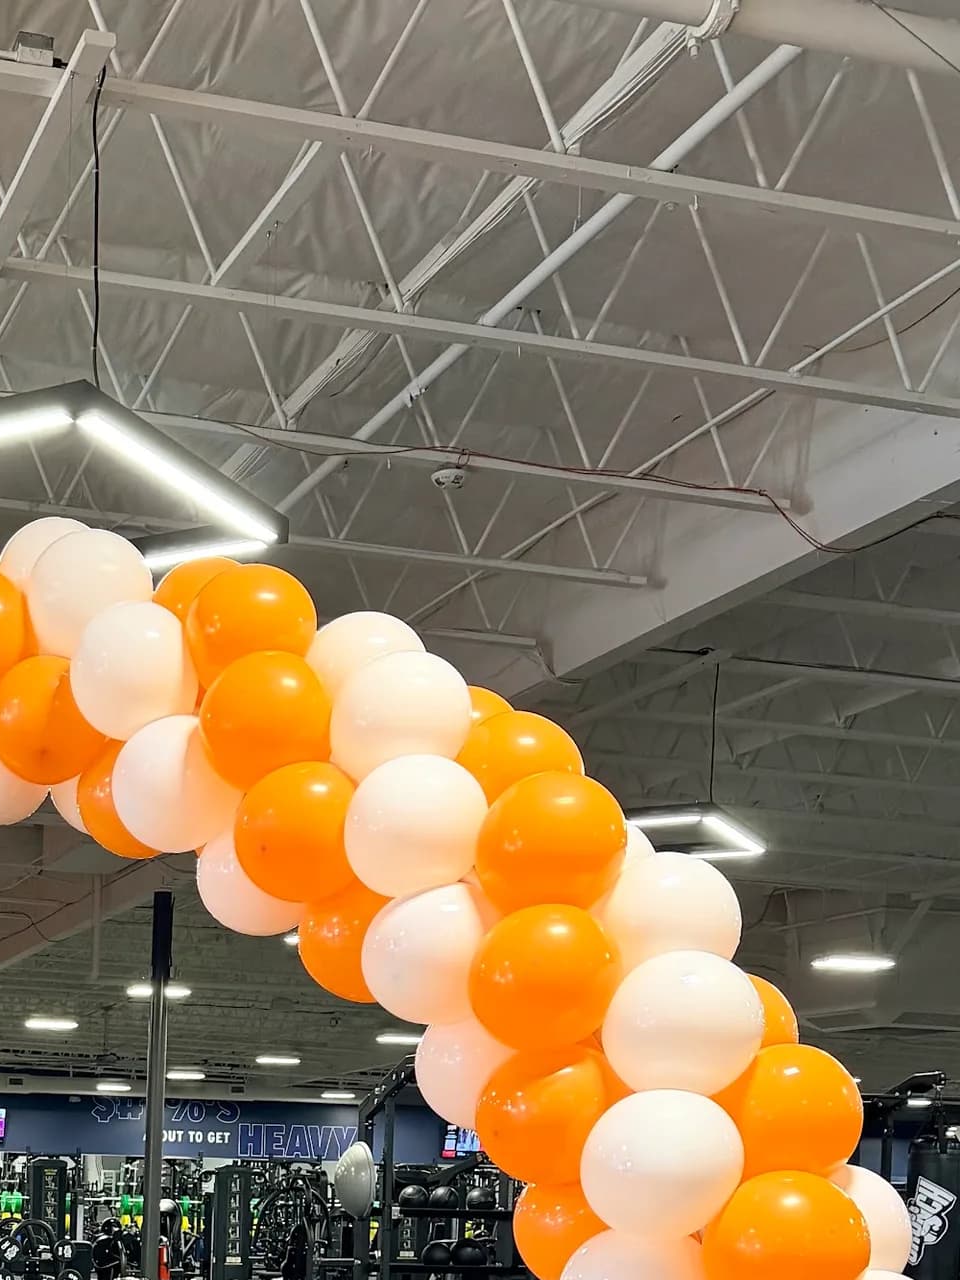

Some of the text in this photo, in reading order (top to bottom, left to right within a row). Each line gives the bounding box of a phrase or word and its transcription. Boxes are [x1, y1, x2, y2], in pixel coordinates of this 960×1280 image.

[143, 1123, 358, 1159] OUT TO GET HEAVY
